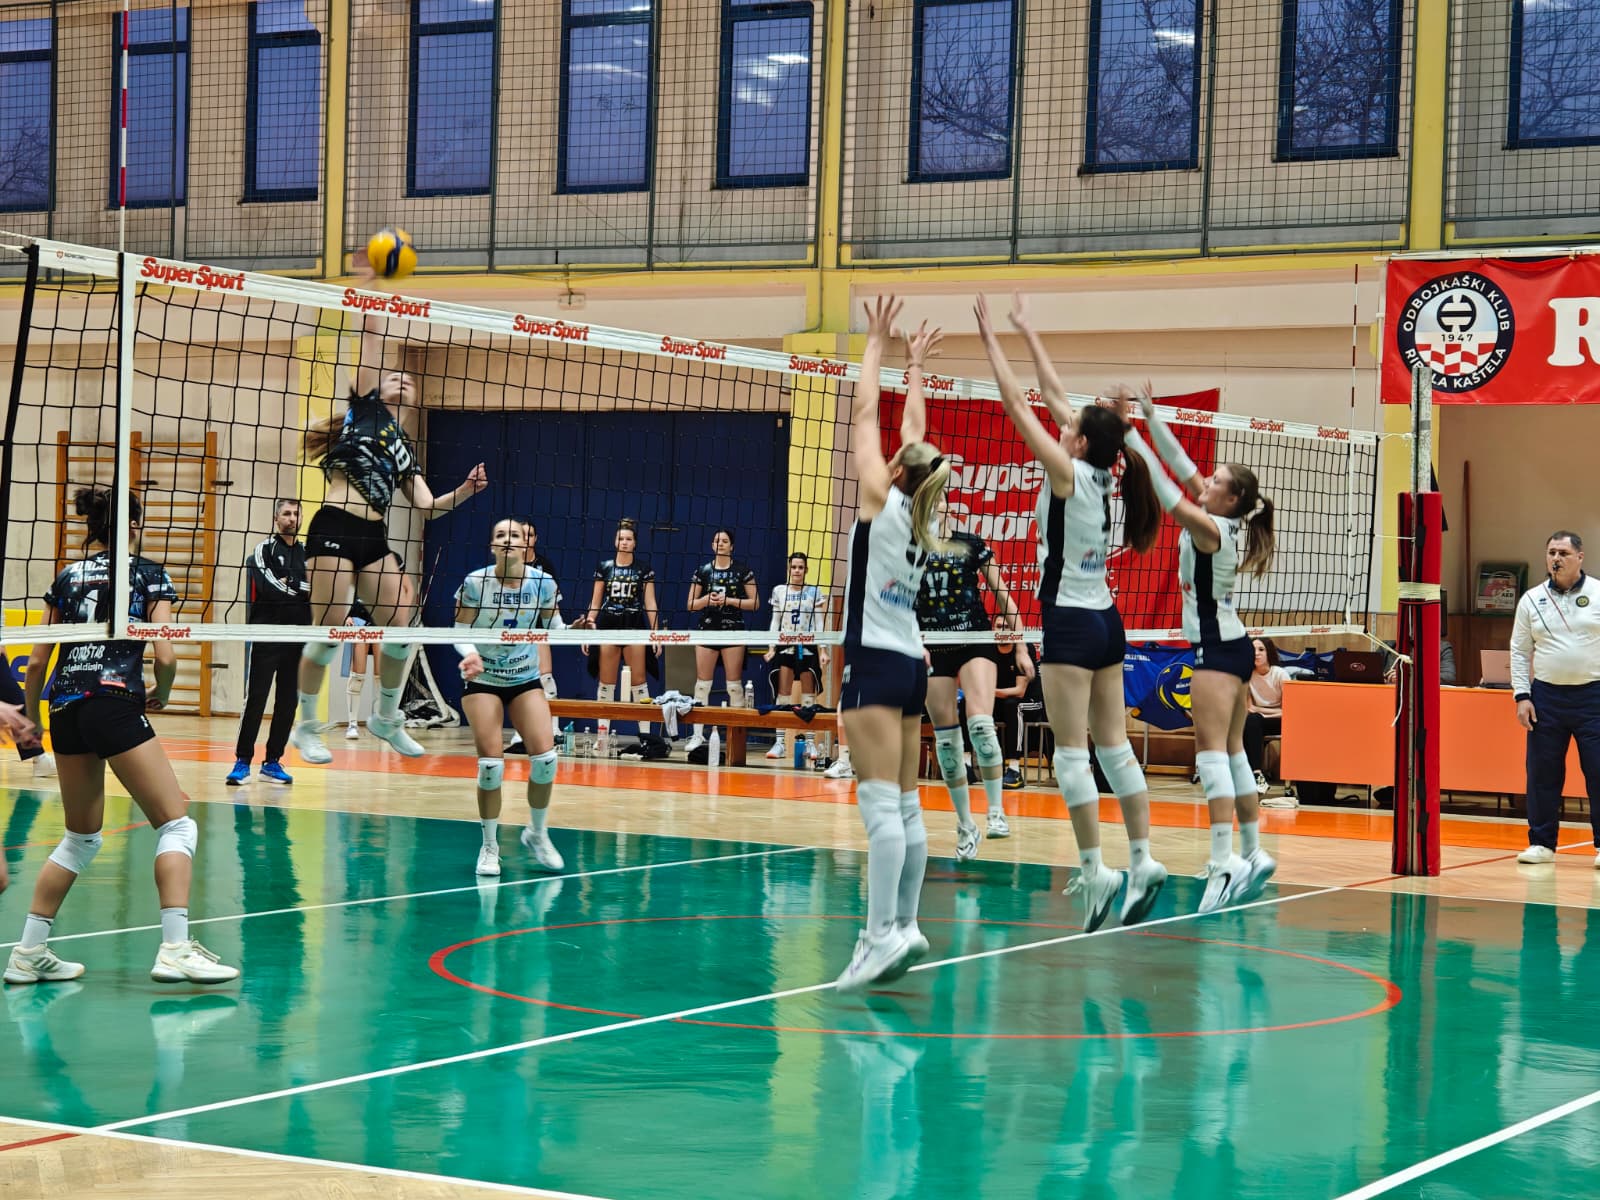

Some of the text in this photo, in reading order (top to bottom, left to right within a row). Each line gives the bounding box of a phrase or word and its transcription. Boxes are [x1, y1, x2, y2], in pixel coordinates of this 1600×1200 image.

[140, 257, 245, 292] SuperSport
[342, 288, 431, 319] SuperSport
[1403, 274, 1511, 332] ODBOJKAŠKI KLUB
[512, 314, 590, 343] SuperSport
[1441, 333, 1473, 343] 1947
[660, 336, 728, 361] SuperSport
[788, 354, 849, 379] SuperSport
[1405, 347, 1507, 389] RIBLA KAŠTELA
[925, 570, 949, 598] 17
[791, 608, 801, 625] 2
[126, 624, 192, 640] SuperSport
[327, 628, 385, 642] SuperSport
[500, 630, 549, 643] SuperSport
